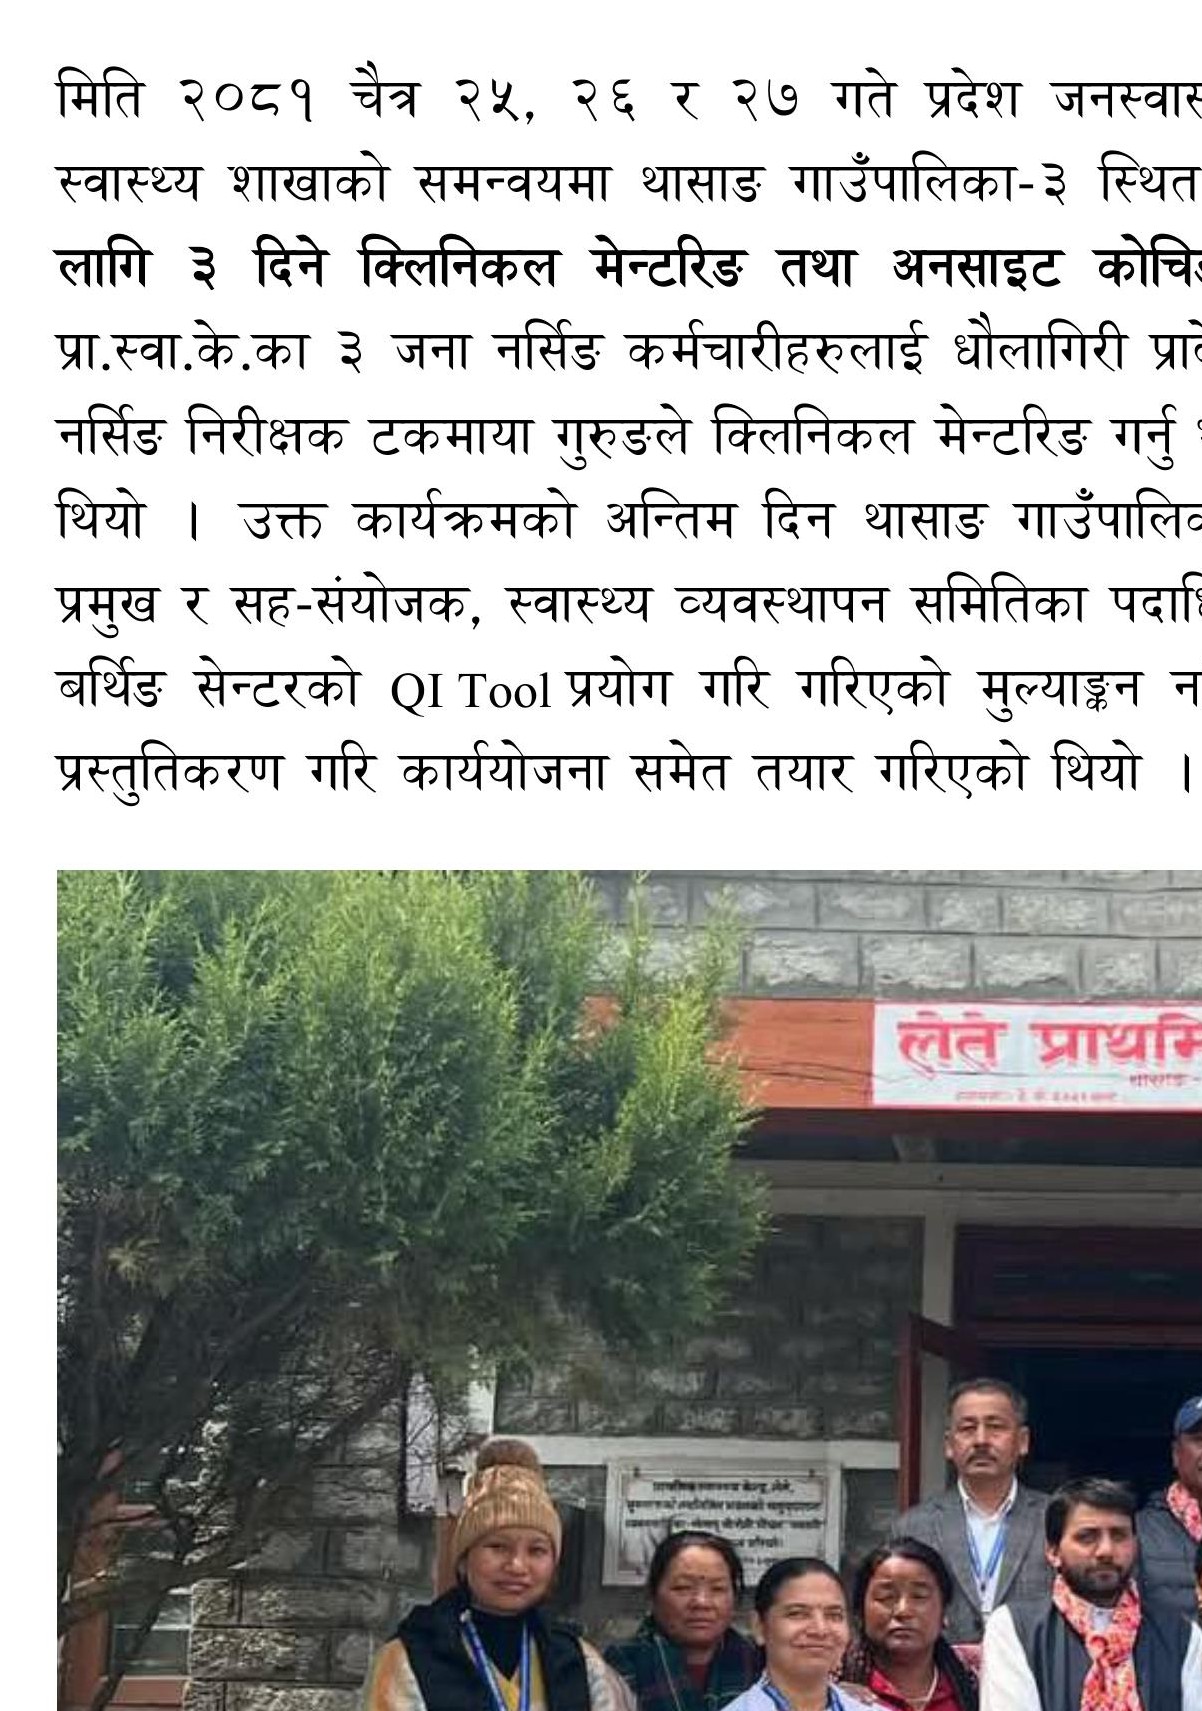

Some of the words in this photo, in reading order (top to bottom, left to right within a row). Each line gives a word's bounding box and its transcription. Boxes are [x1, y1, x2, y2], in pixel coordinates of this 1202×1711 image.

[54, 66, 146, 118] मिति
[180, 79, 311, 122] २०८१
[349, 61, 422, 118] चैत्र
[456, 79, 533, 124] २५,
[572, 80, 635, 121] २६
[670, 83, 700, 119] र
[732, 79, 797, 121] २७
[830, 67, 898, 117] गते
[923, 67, 1023, 118] प्रदेश
[54, 167, 204, 202] स्वास्थ्य
[227, 150, 391, 202] शाखाको
[413, 167, 613, 203] समन्वयमा
[643, 167, 766, 203] थासाङ
[788, 150, 1065, 205] गाउँपालिका-३
[1097, 150, 1202, 203] स्थित
[52, 234, 154, 287] लागि
[189, 247, 215, 290] ३
[251, 234, 331, 287] दिने
[356, 234, 563, 287] क्लिनिकल
[588, 234, 749, 288] मेन्टरिङ
[775, 250, 859, 287] तथा
[893, 250, 1066, 291] अनसाइट
[54, 319, 311, 371] प्रा.स्वा.के.का
[338, 331, 361, 373] ३
[390, 335, 473, 370] जना
[491, 318, 605, 371] नर्सिङ
[623, 319, 929, 374] कर्मचारीहरुलाई
[955, 311, 1129, 371] धौलागिरी
[54, 487, 147, 539] थियो
[237, 504, 329, 539] उक्त
[351, 487, 578, 539] कार्यक्रमको
[607, 487, 739, 538] अन्तिम
[761, 488, 837, 539] दिन
[866, 504, 989, 540] थासाङ
[54, 655, 167, 707] बर्थिङ
[192, 655, 362, 708] सेन्टरको
[392, 673, 442, 717] QI
[459, 672, 551, 708] Tool
[564, 655, 674, 707] प्रयोग
[698, 656, 771, 708] गरि
[795, 655, 951, 715] गरिएको
[976, 672, 1144, 722] मुल्याङ्कन
[54, 739, 286, 806] प्रस्तुतिकरण
[305, 740, 378, 792] गरि
[397, 739, 610, 791] कार्ययोजना
[629, 739, 732, 792] समेत
[751, 756, 855, 792] तयार
[874, 739, 1030, 799] गरिएको
[1050, 739, 1143, 791] थियो
[897, 1011, 1008, 1079] लेते
